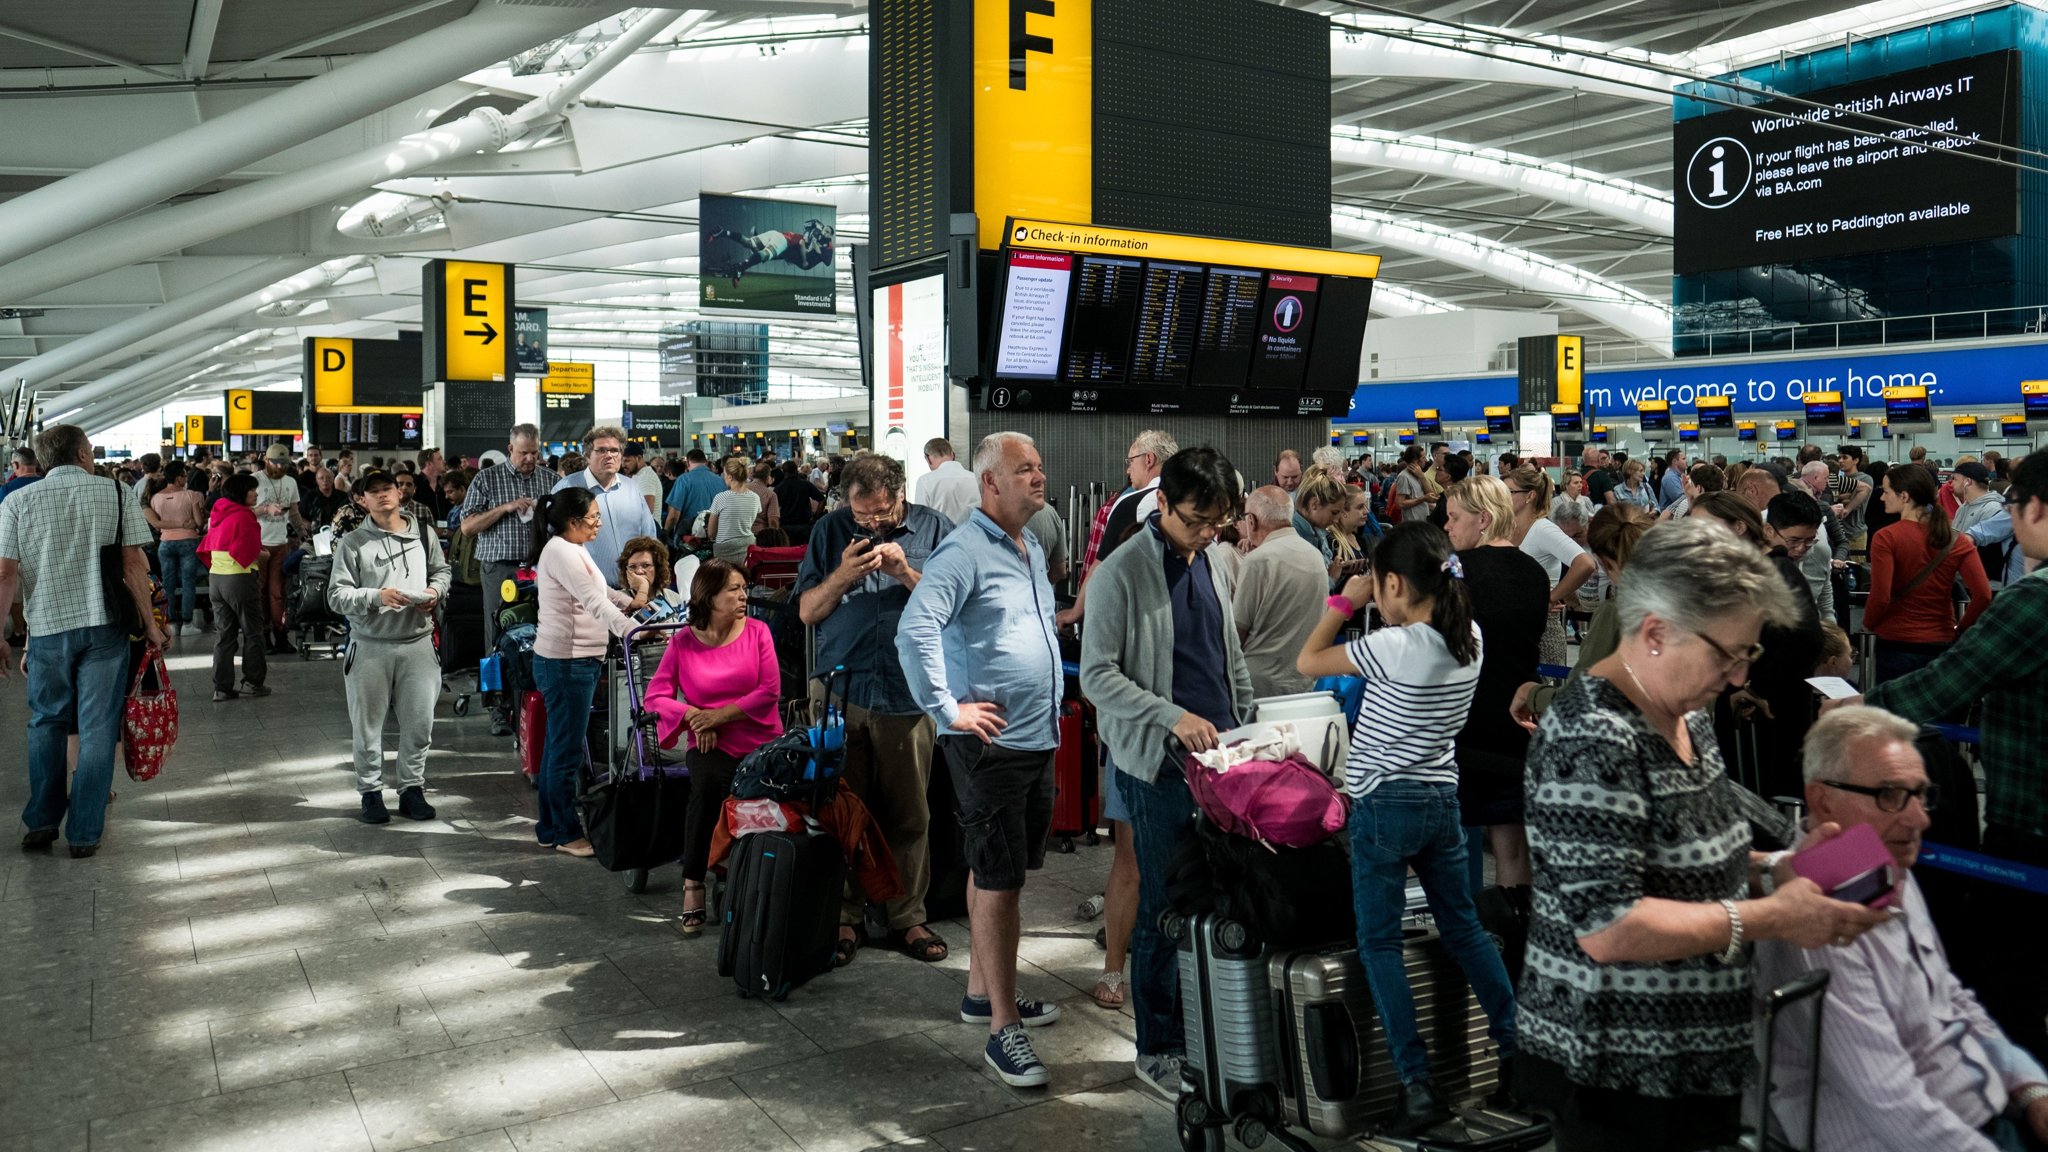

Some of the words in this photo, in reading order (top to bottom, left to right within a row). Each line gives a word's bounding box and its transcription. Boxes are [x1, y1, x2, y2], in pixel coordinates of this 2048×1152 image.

[1008, 0, 1055, 91] F
[1751, 108, 1830, 134] Worldwide
[1834, 94, 1884, 117] British
[1888, 82, 1953, 107] Airways
[1958, 76, 1974, 93] IT
[1756, 153, 1764, 165] If
[1766, 150, 1792, 166] your
[1794, 142, 1824, 159] flight
[1827, 140, 1850, 152] has
[1854, 134, 1886, 148] been
[1890, 117, 1958, 140] cancelled,
[1755, 167, 1794, 184] please
[1797, 161, 1829, 174] leave
[1833, 156, 1853, 168] the
[1856, 146, 1898, 164] airport
[1902, 141, 1927, 156] and
[1933, 132, 1980, 151] rebook
[1755, 185, 1772, 197] via
[1775, 178, 1822, 194] BA.com
[1755, 230, 1782, 242] Free
[1785, 223, 1813, 238] HEX
[1816, 222, 1828, 234] to
[1832, 212, 1904, 232] Paddington
[1909, 202, 1970, 222] available
[1031, 229, 1080, 244] Check-in
[1083, 233, 1148, 250] information
[1036, 254, 1064, 262] information
[463, 279, 488, 317] E
[794, 294, 819, 302] Standard
[798, 300, 831, 308] Investments
[323, 348, 345, 372] D
[1564, 346, 1575, 370] E
[1620, 378, 1737, 406] welcome
[1747, 378, 1775, 403] to
[1786, 376, 1836, 402] our
[1848, 368, 1944, 398] home.
[234, 396, 246, 410] C
[192, 419, 199, 428] B
